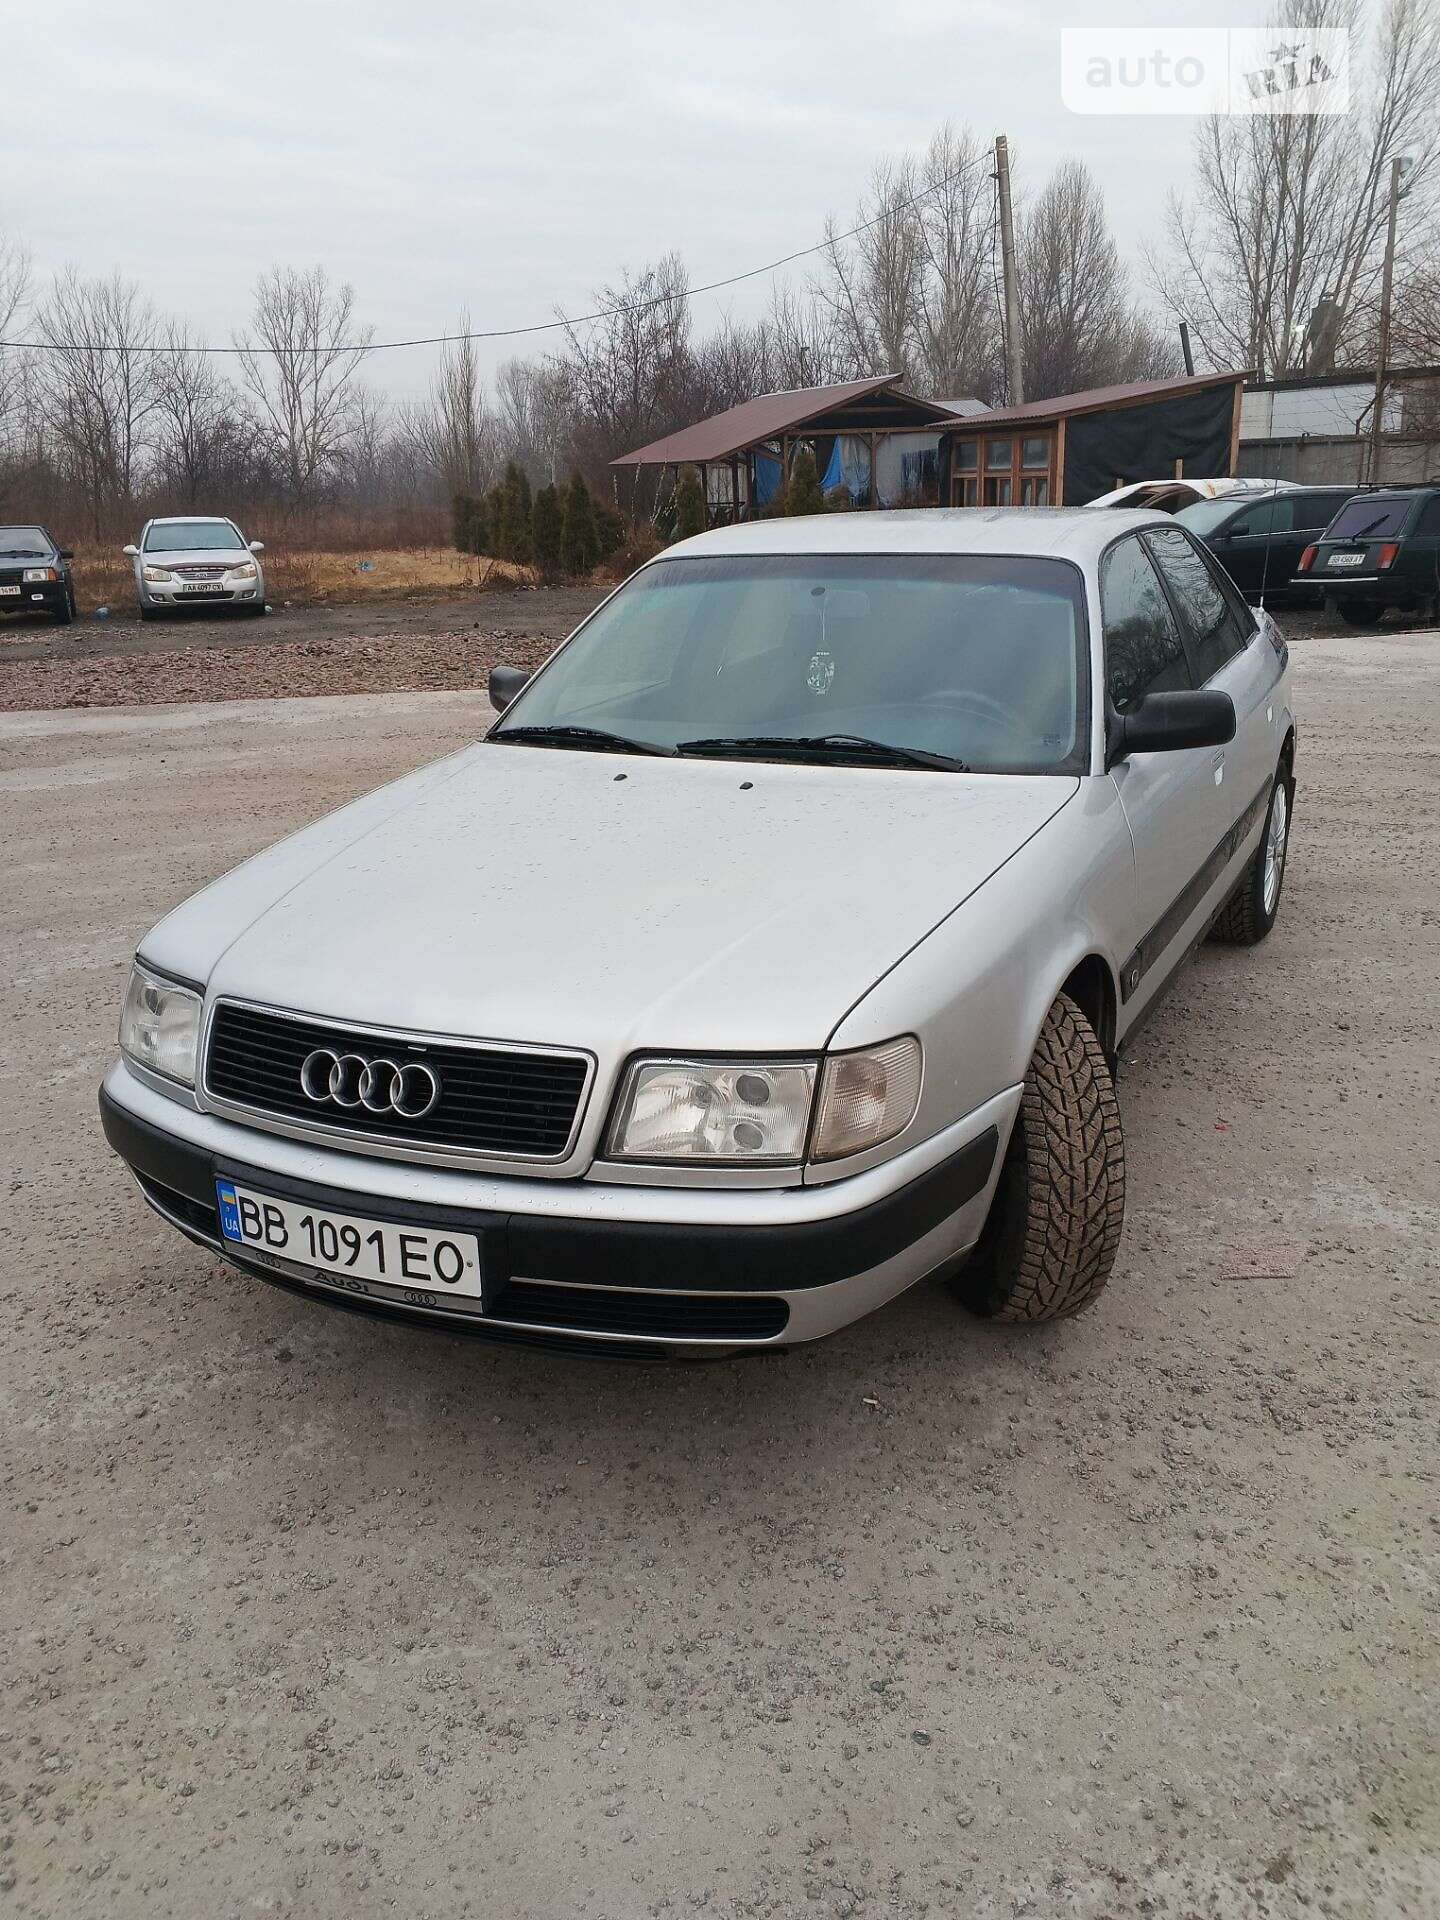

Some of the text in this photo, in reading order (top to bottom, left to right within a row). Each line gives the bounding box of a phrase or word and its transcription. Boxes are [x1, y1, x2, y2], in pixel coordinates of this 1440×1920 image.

[225, 1217, 239, 1232] UA
[238, 1196, 464, 1284] BB 1091 EO
